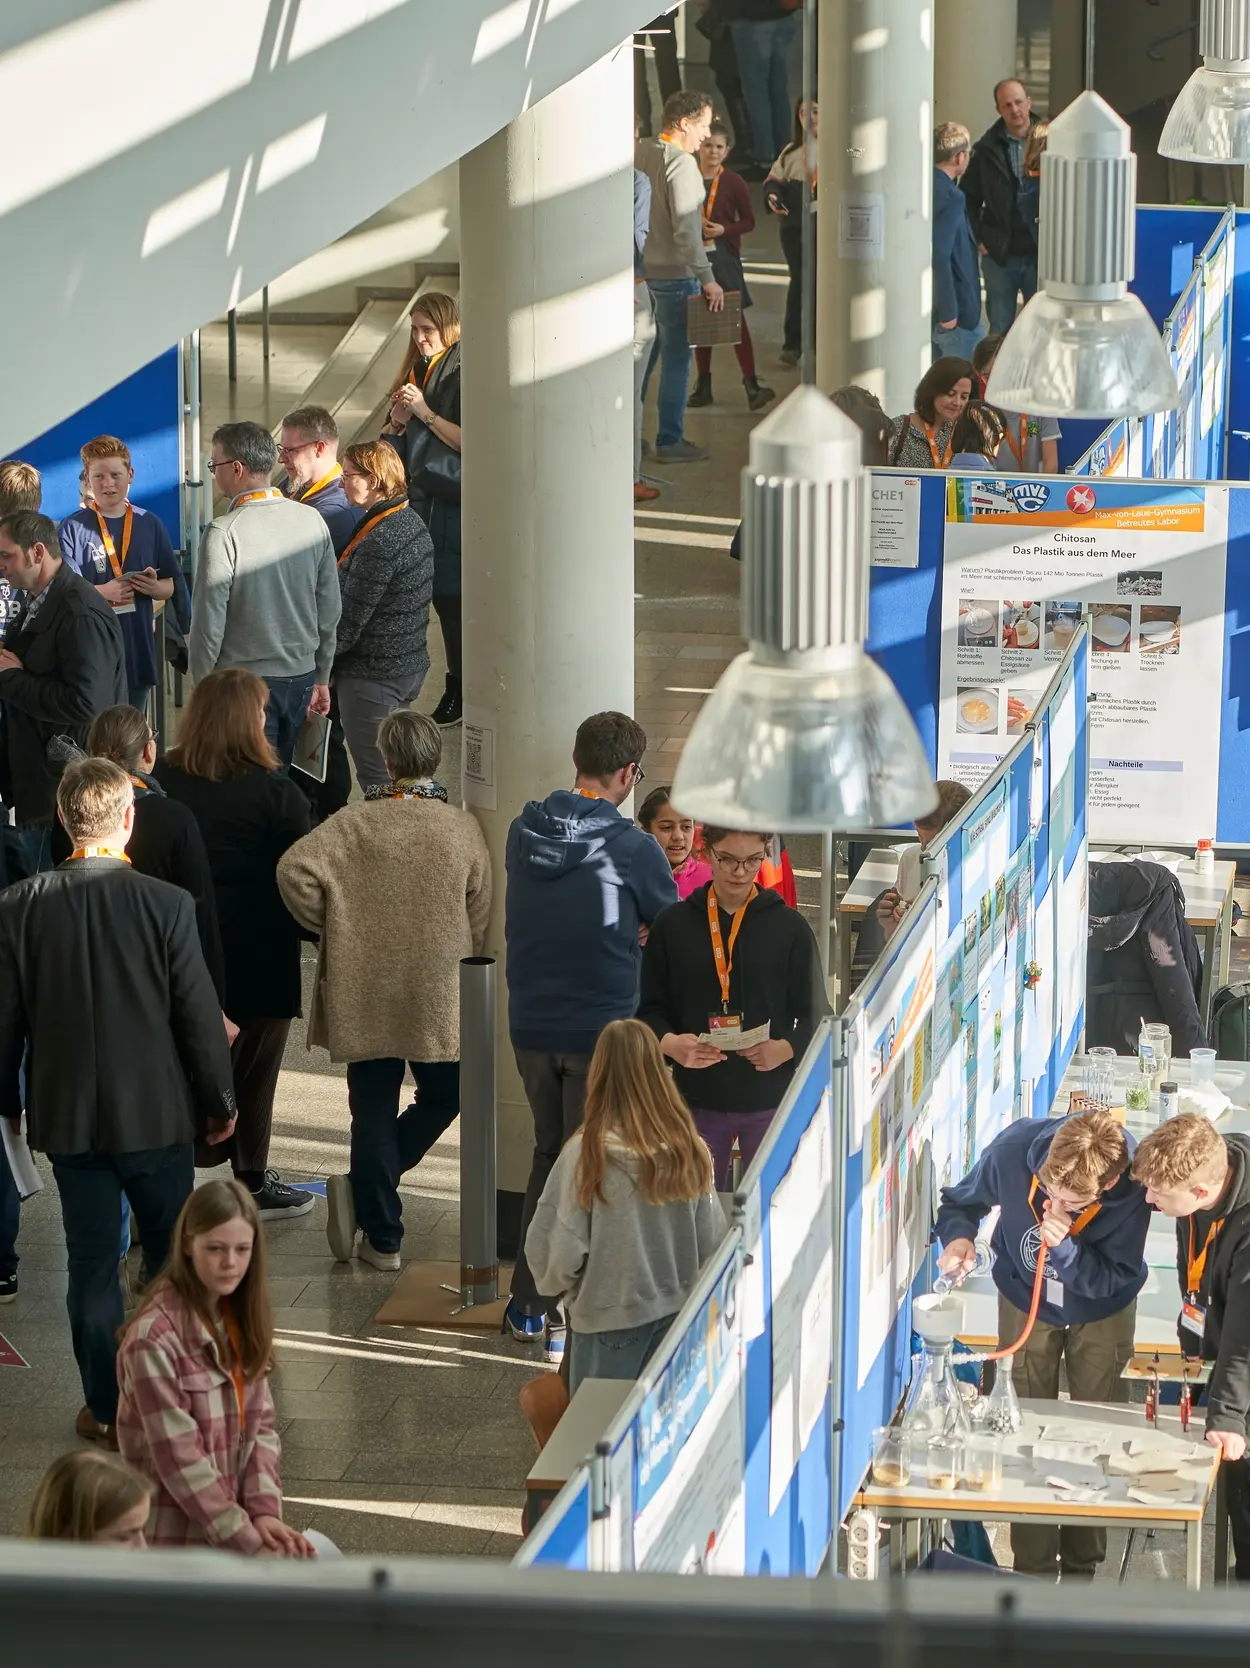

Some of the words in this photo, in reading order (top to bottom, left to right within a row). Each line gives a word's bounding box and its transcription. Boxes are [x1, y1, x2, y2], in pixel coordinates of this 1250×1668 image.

[872, 489, 904, 501] CHE1
[1013, 484, 1048, 499] MVL
[1095, 507, 1200, 519] Max-von-Laue-Gymnasium
[1117, 519, 1155, 528] Betreutes
[1157, 517, 1179, 526] Labor
[1053, 533, 1096, 543] Chitosan
[1012, 546, 1031, 555] Das
[1033, 546, 1065, 556] Plastik
[1086, 548, 1108, 558] dem
[1111, 549, 1137, 559] Meer
[1000, 661, 1030, 669] Essigsäure
[1123, 717, 1150, 725] herstellen,
[1108, 760, 1144, 769] Nachteile
